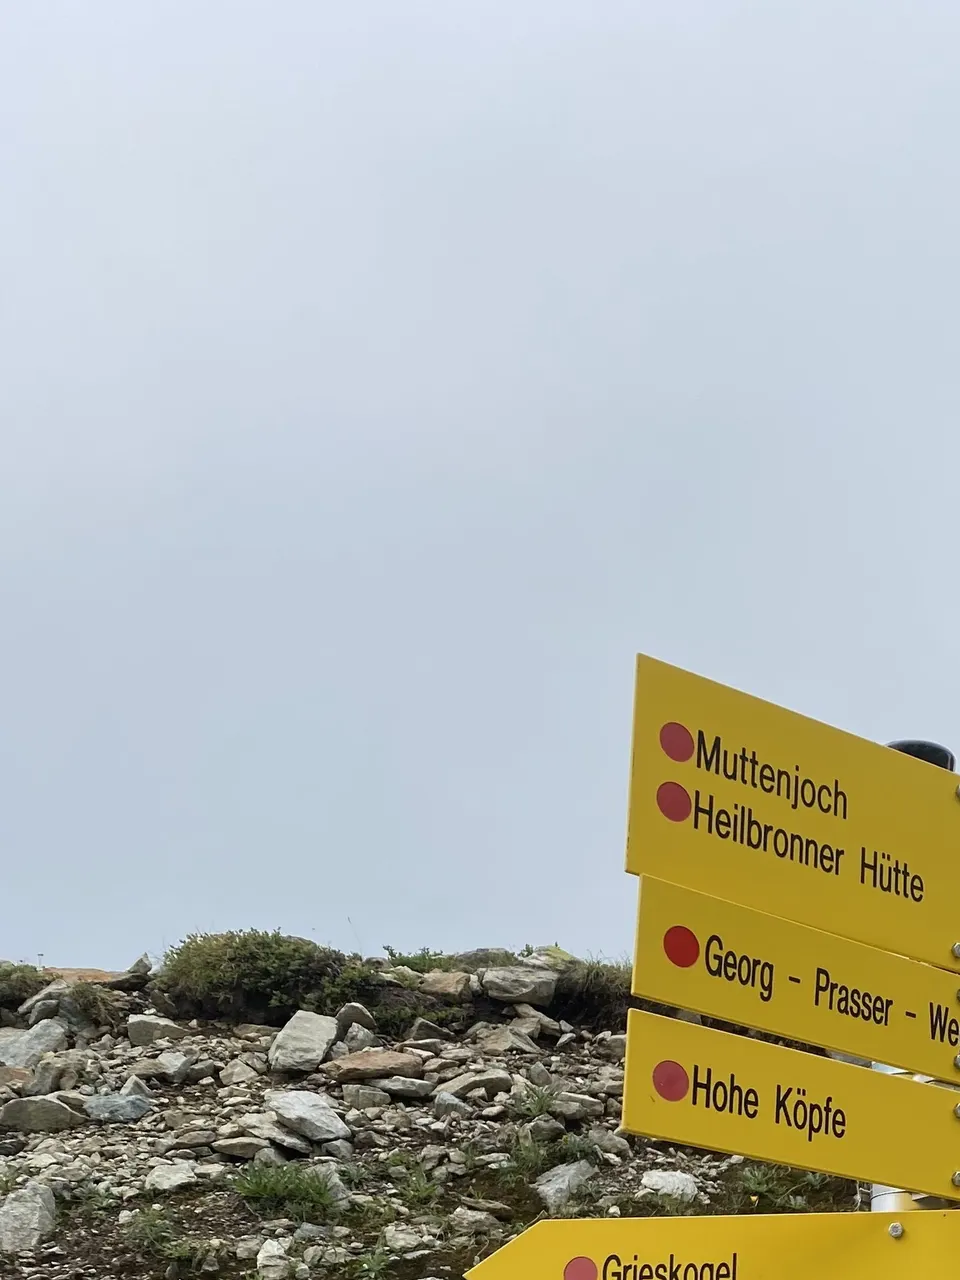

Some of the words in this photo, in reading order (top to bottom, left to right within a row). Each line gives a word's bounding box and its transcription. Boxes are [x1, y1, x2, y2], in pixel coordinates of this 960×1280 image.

[696, 730, 848, 819] Muttenjoch
[693, 790, 844, 875] Heilbronner
[860, 847, 924, 902] Hütte
[705, 935, 774, 1002] Georg
[814, 967, 893, 1026] Prasser
[692, 1064, 759, 1118] Hohe
[775, 1084, 846, 1142] Köpfe
